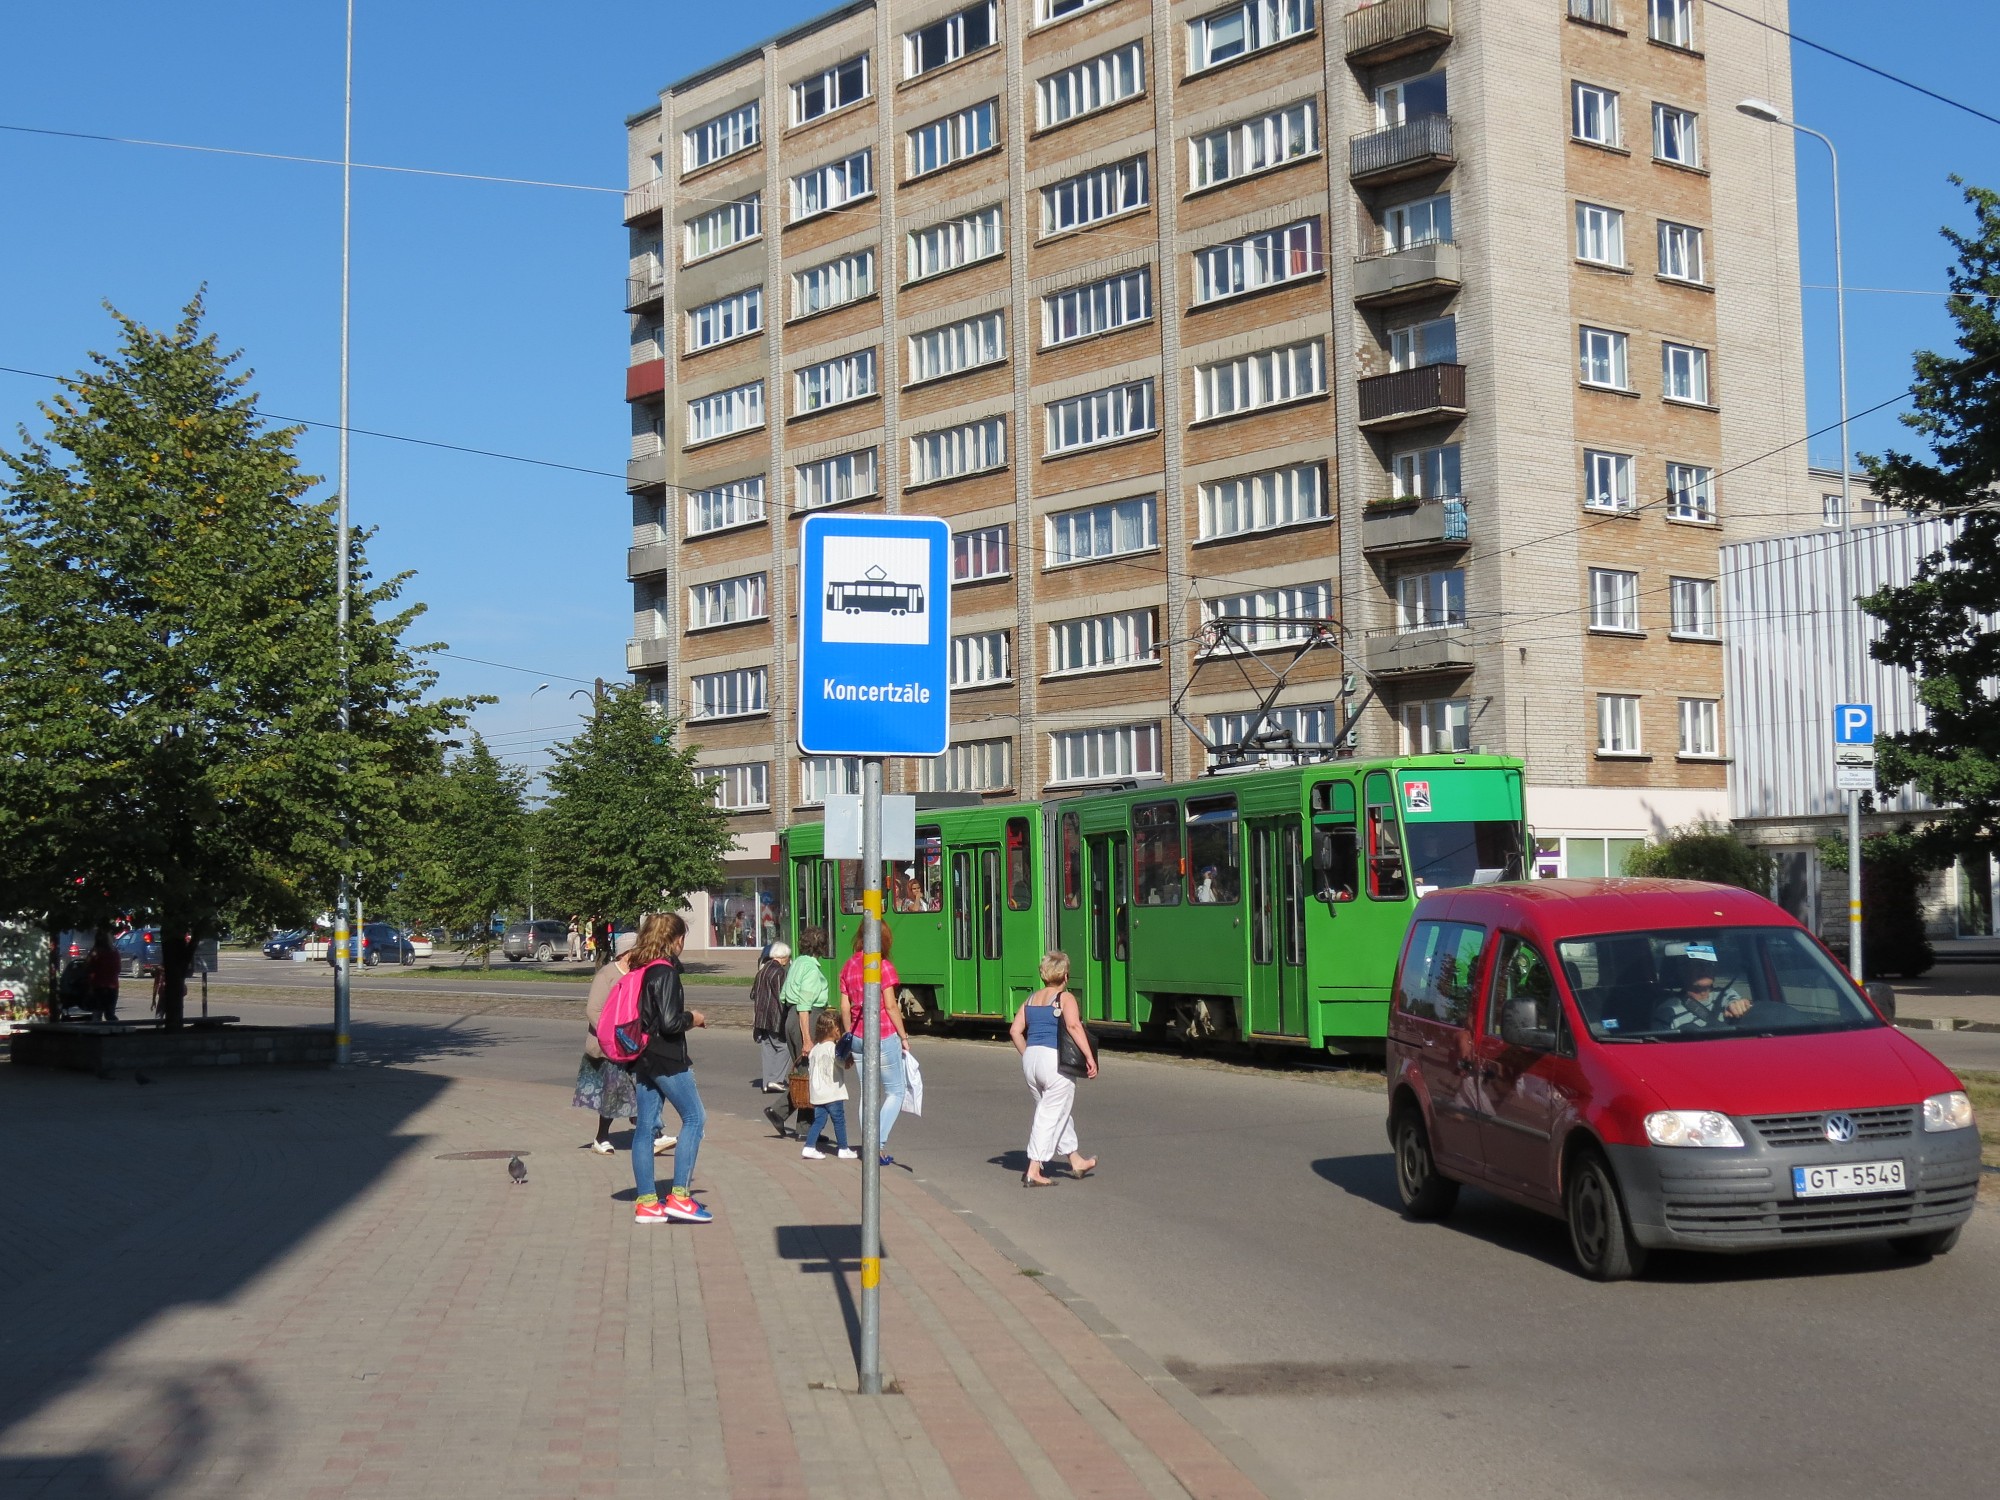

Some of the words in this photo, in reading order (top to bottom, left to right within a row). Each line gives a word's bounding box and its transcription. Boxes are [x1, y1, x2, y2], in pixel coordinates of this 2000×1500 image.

[823, 678, 930, 704] Koncertzāle
[1845, 708, 1867, 740] P
[1811, 1164, 1901, 1189] GT-5549
